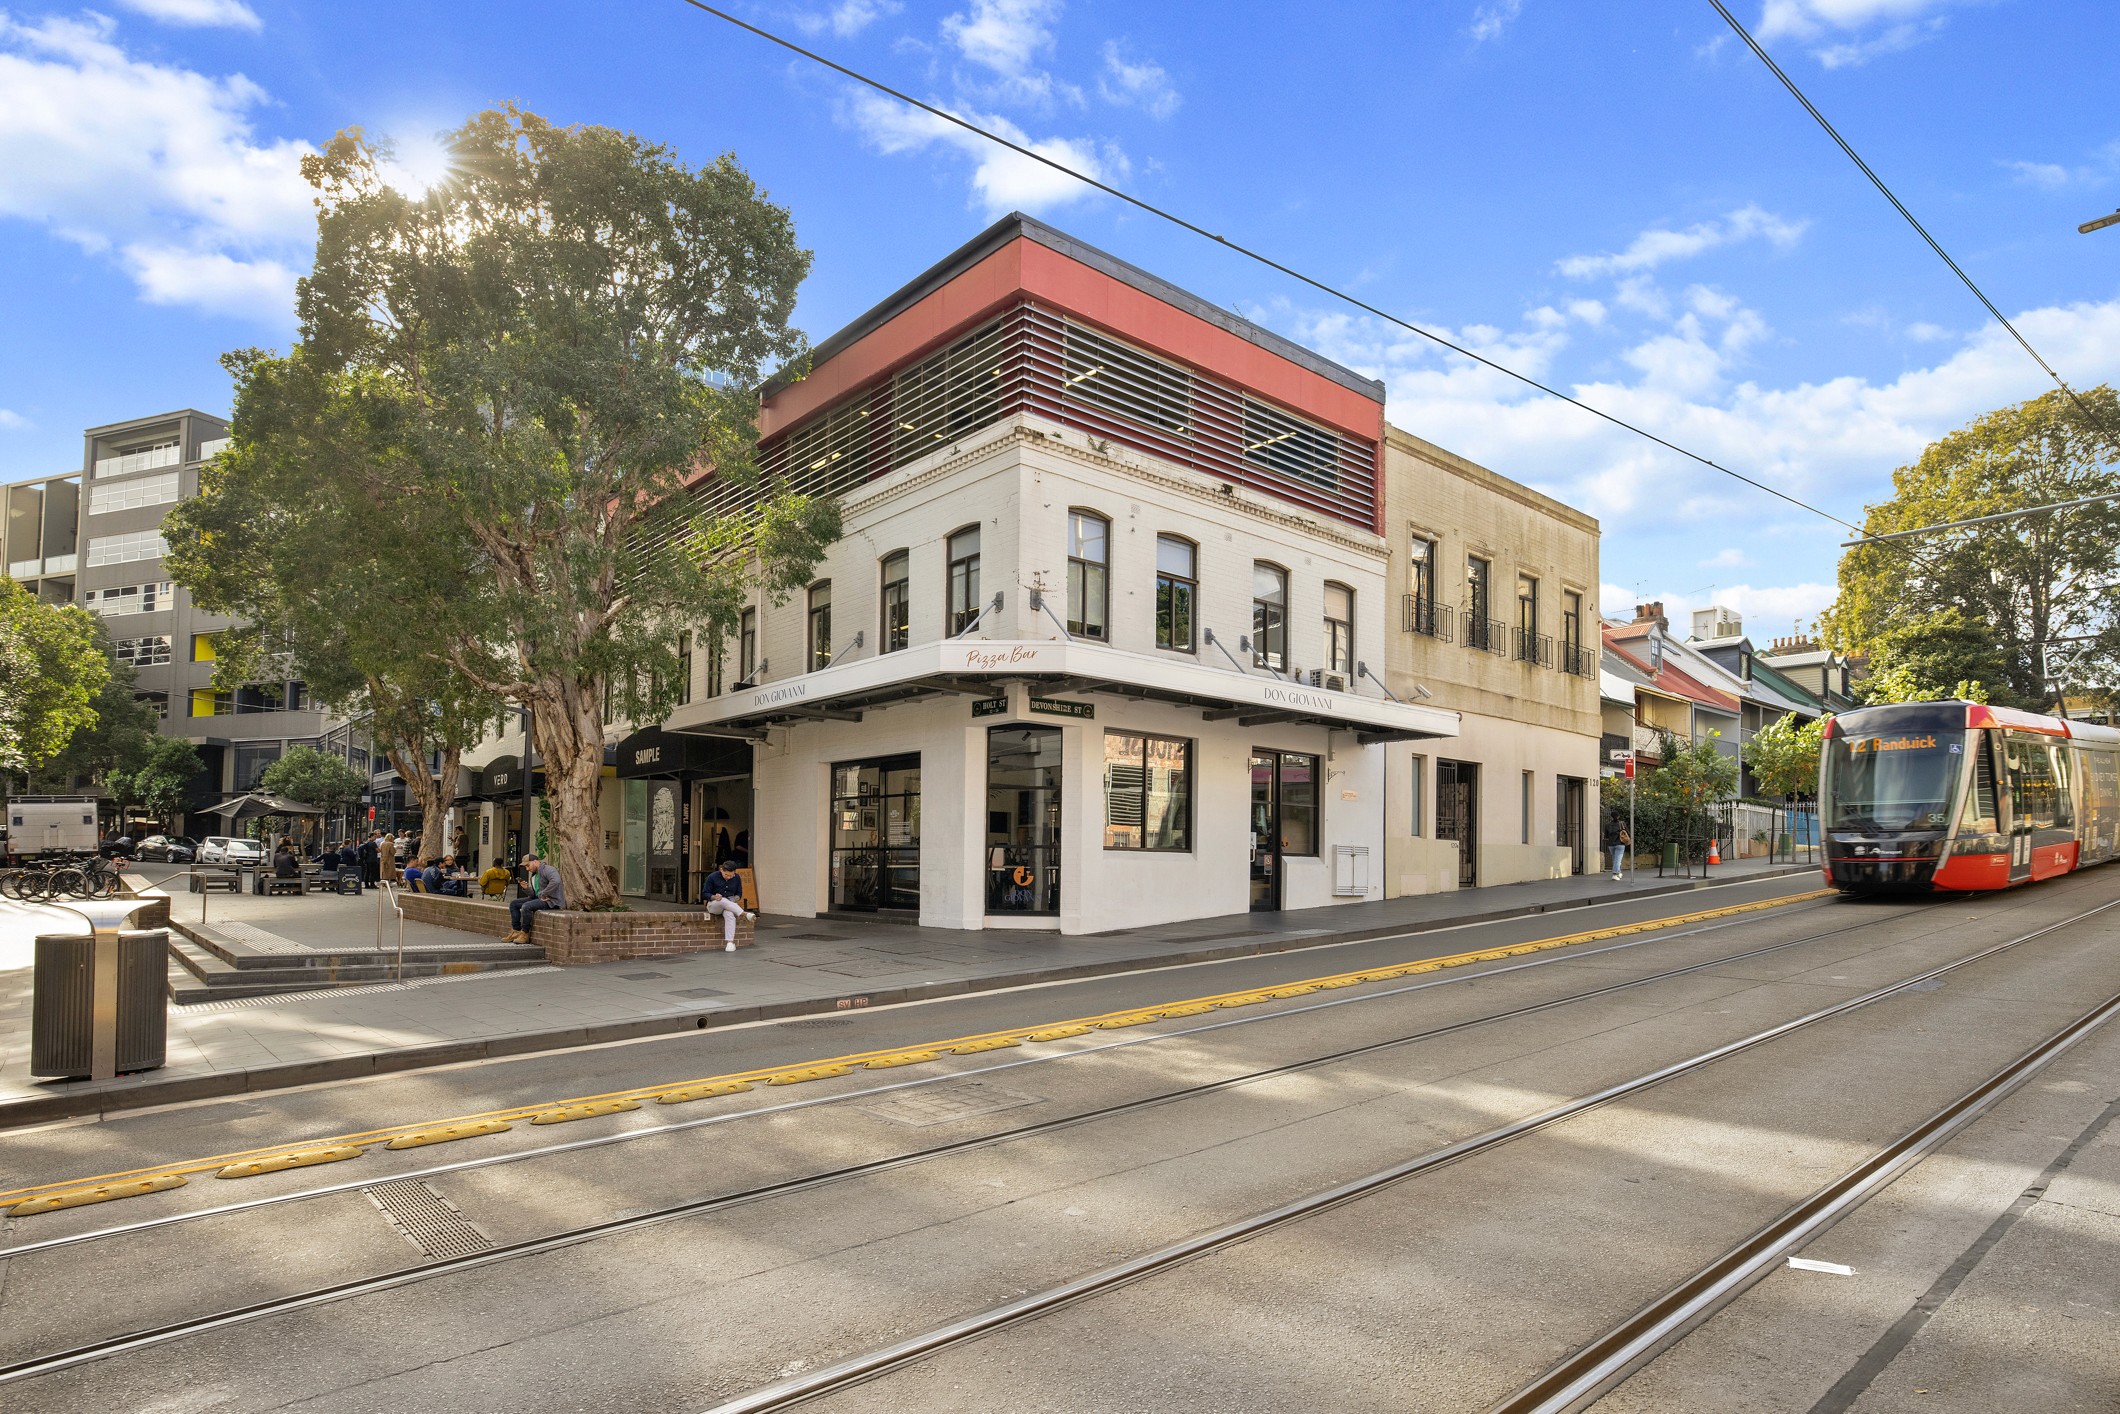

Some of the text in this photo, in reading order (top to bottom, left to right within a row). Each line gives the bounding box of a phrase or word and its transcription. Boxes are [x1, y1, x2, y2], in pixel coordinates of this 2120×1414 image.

[966, 646, 1038, 669] Pizza Bar
[754, 684, 805, 706] DON GIOVANNI
[1264, 687, 1332, 709] DON GIOVANNI
[982, 699, 1007, 709] HOLT ST
[1031, 701, 1082, 714] DEVONSHIRE ST
[1873, 735, 1937, 752] Randwick
[635, 747, 660, 765] SAMPLE
[1589, 778, 1600, 787] 120
[1927, 813, 1945, 823] 35
[839, 998, 867, 1009] SV HP
